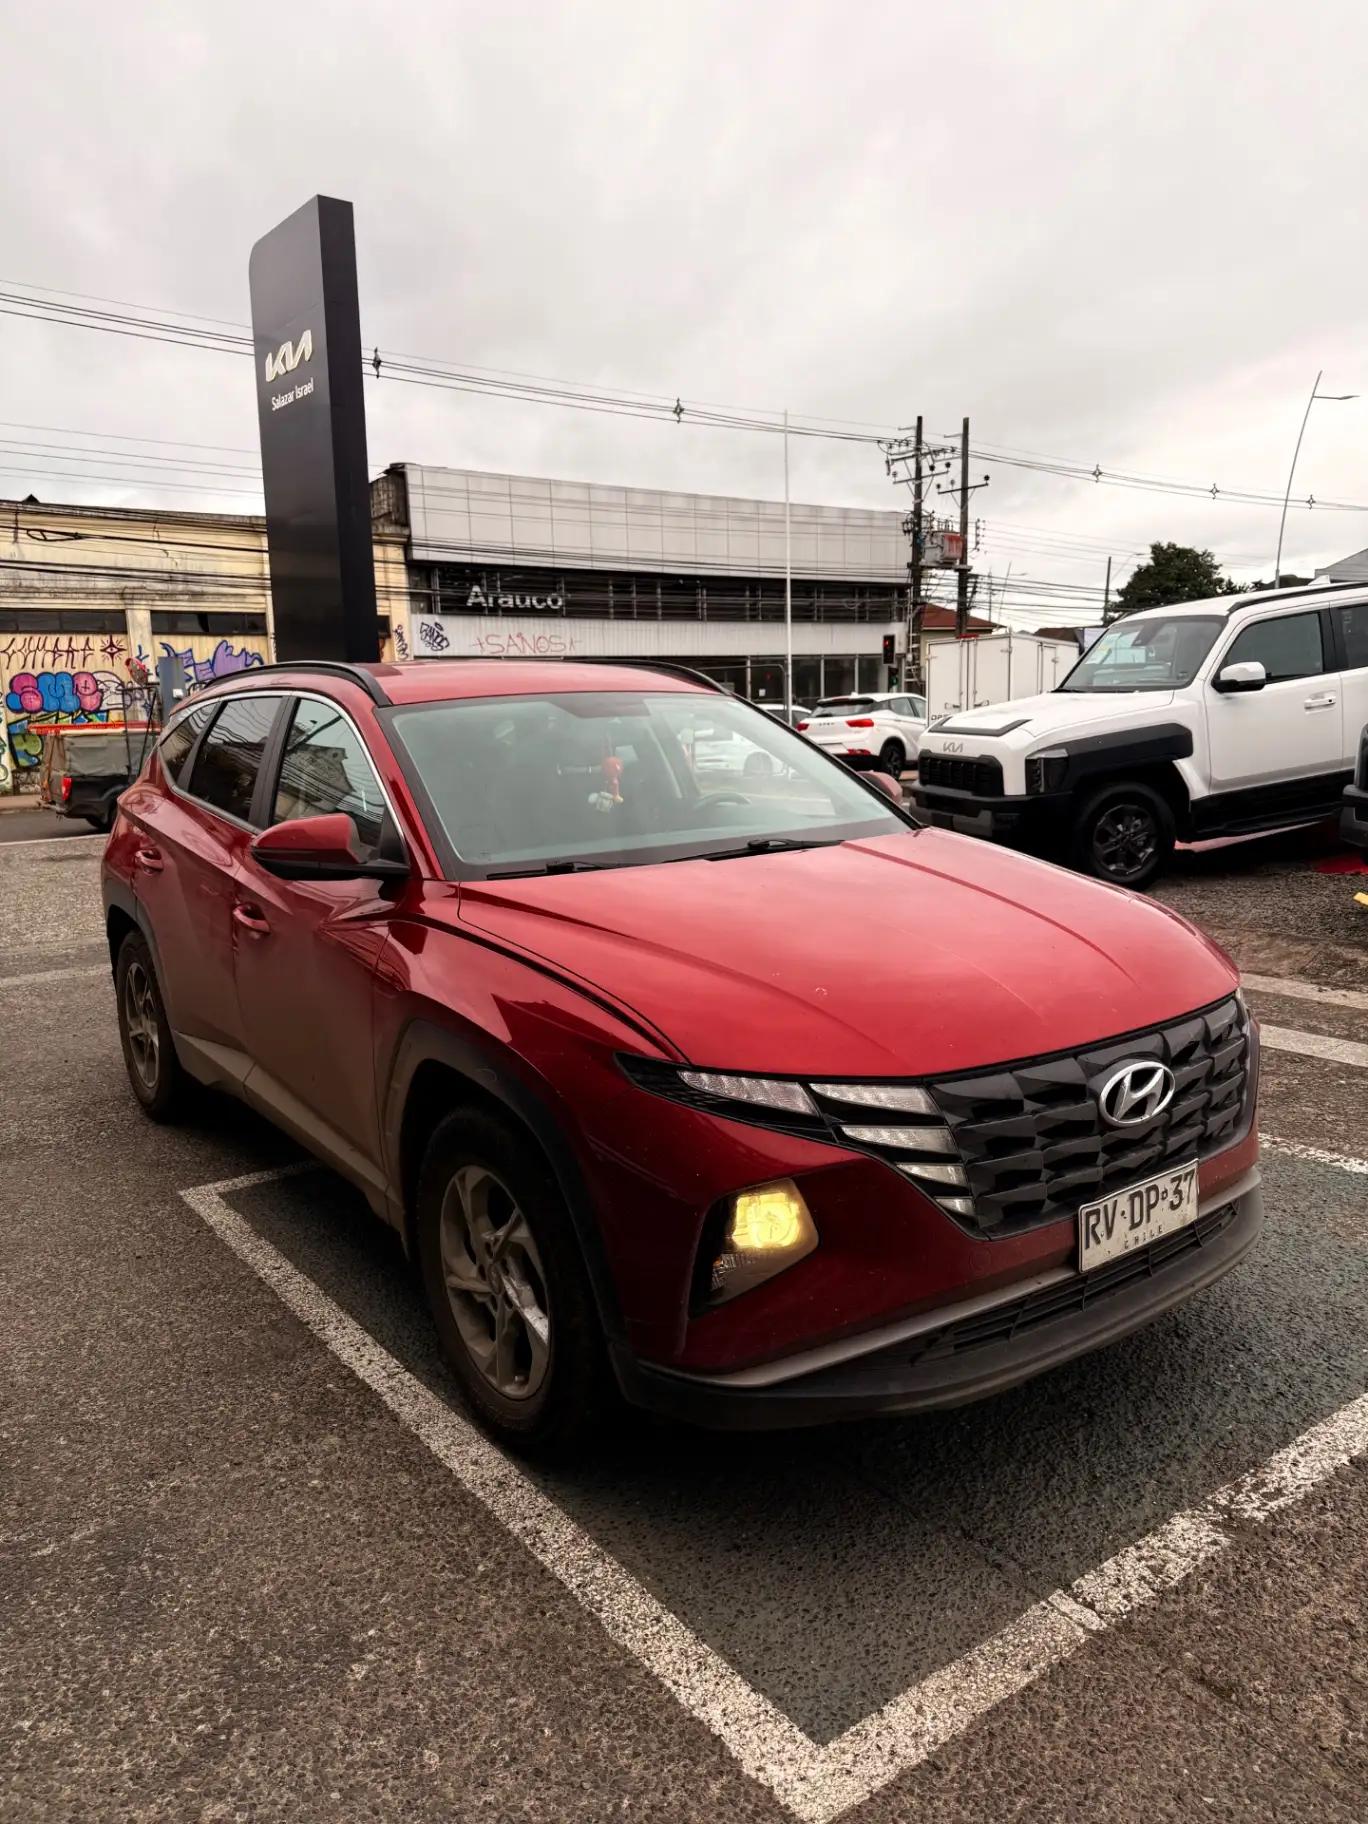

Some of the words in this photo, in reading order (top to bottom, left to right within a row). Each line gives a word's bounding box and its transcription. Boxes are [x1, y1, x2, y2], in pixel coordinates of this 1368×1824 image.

[265, 329, 313, 383] KIA
[271, 391, 295, 411] Salazar
[295, 377, 314, 399] Israel
[466, 584, 563, 609] Arauco
[943, 741, 964, 753] KIA
